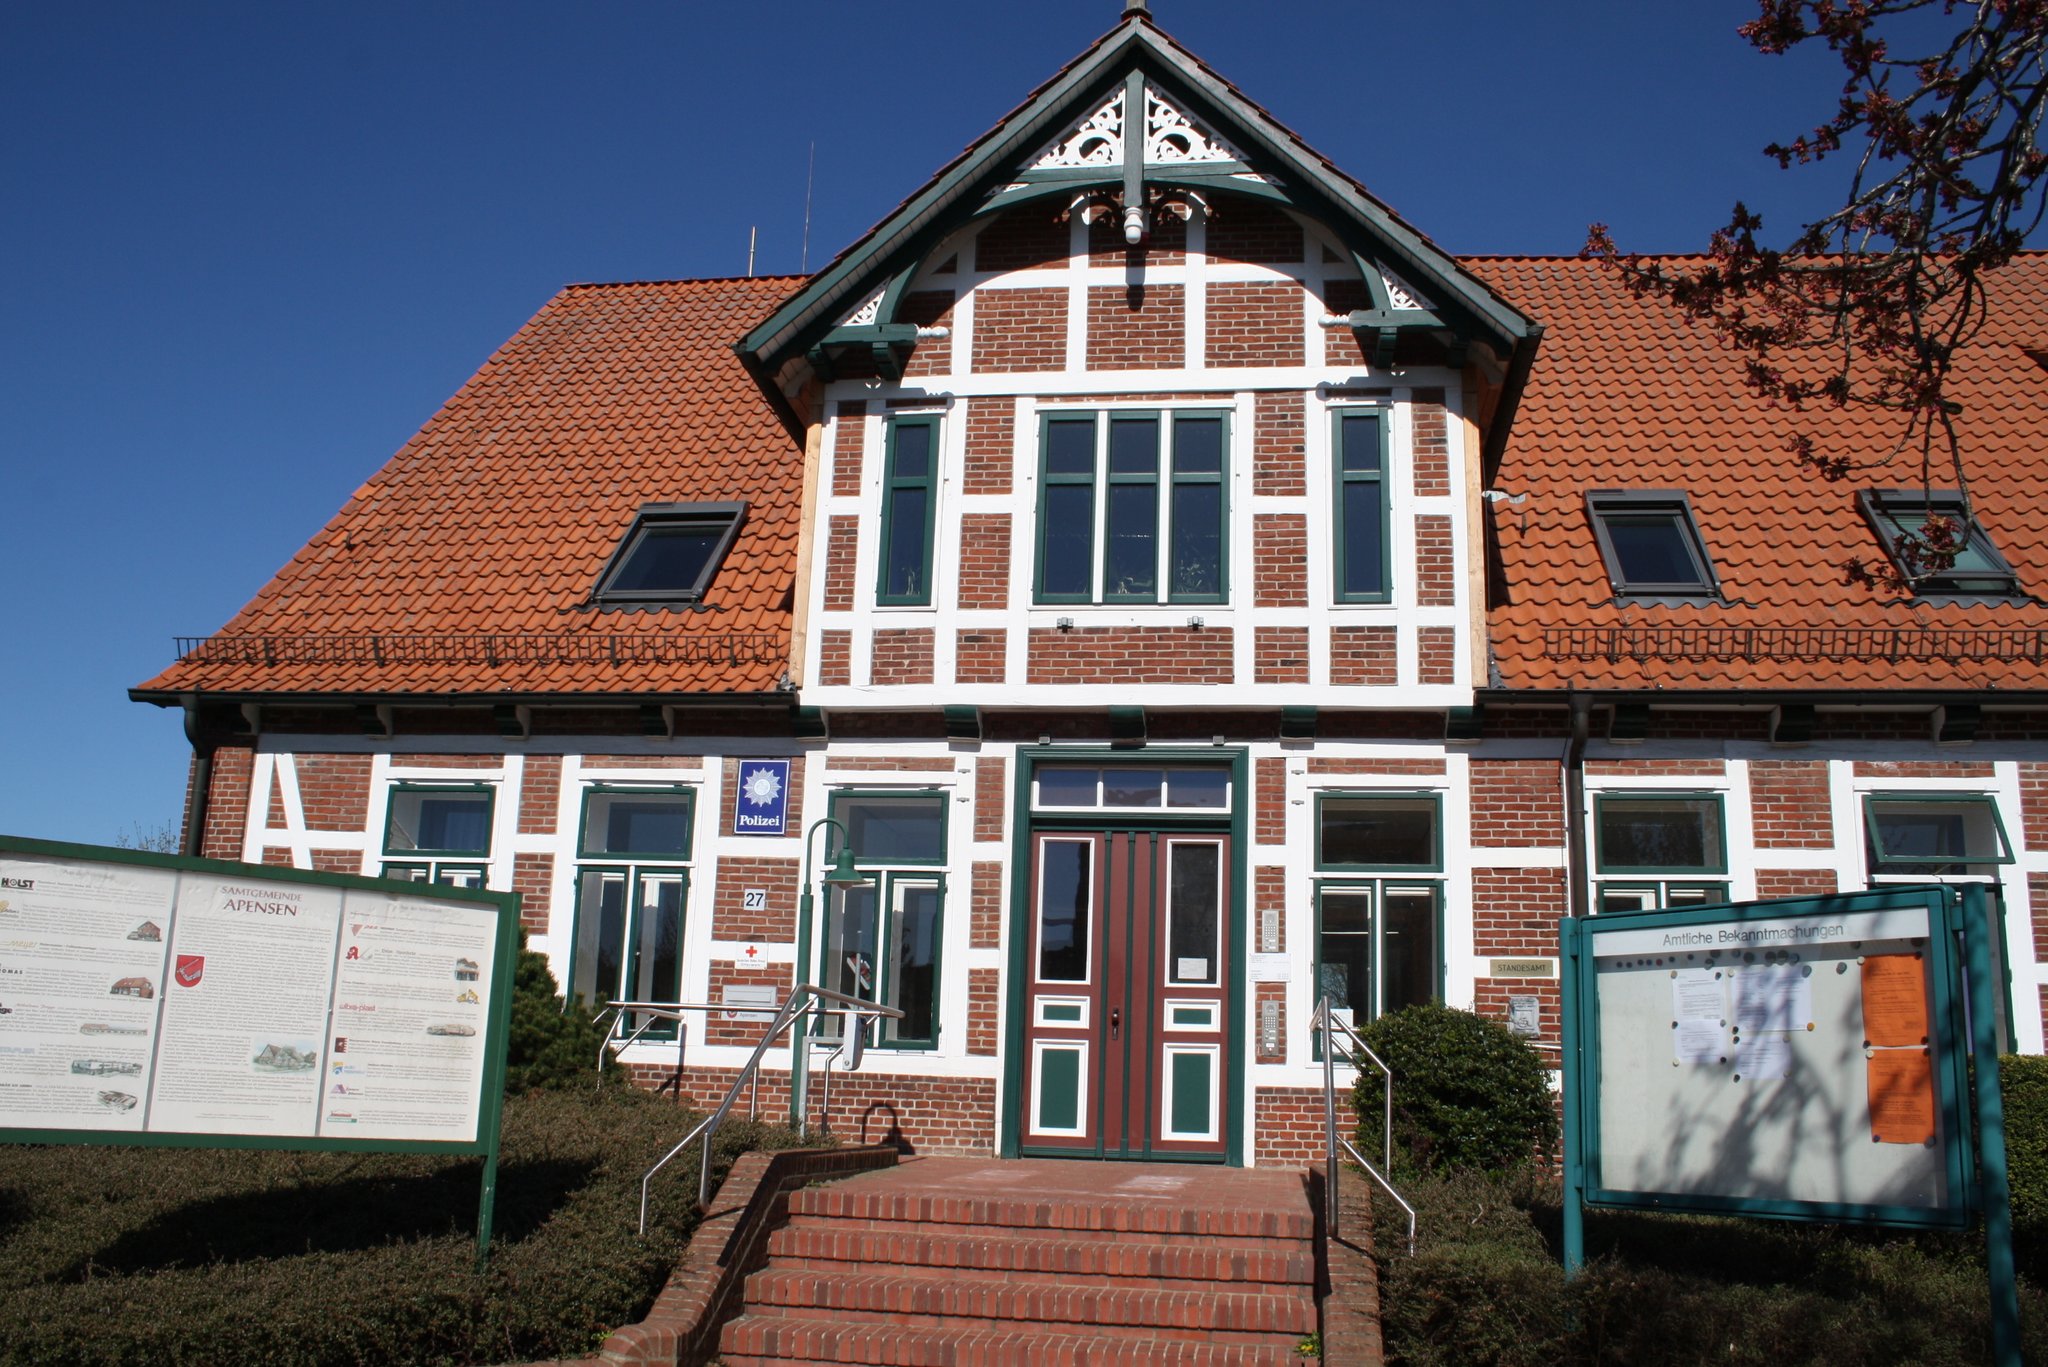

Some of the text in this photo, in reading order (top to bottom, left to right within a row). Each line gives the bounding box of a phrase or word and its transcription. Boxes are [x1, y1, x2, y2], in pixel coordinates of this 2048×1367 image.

[739, 814, 780, 826] Polizei
[1, 877, 35, 889] HOLST
[221, 886, 303, 901] SAMTGEMEINDE
[746, 892, 764, 907] 27
[223, 899, 298, 916] APENSEN
[1663, 924, 1844, 946] Amtliche Bekanntmachungen
[1498, 964, 1546, 972] STANDESAMT
